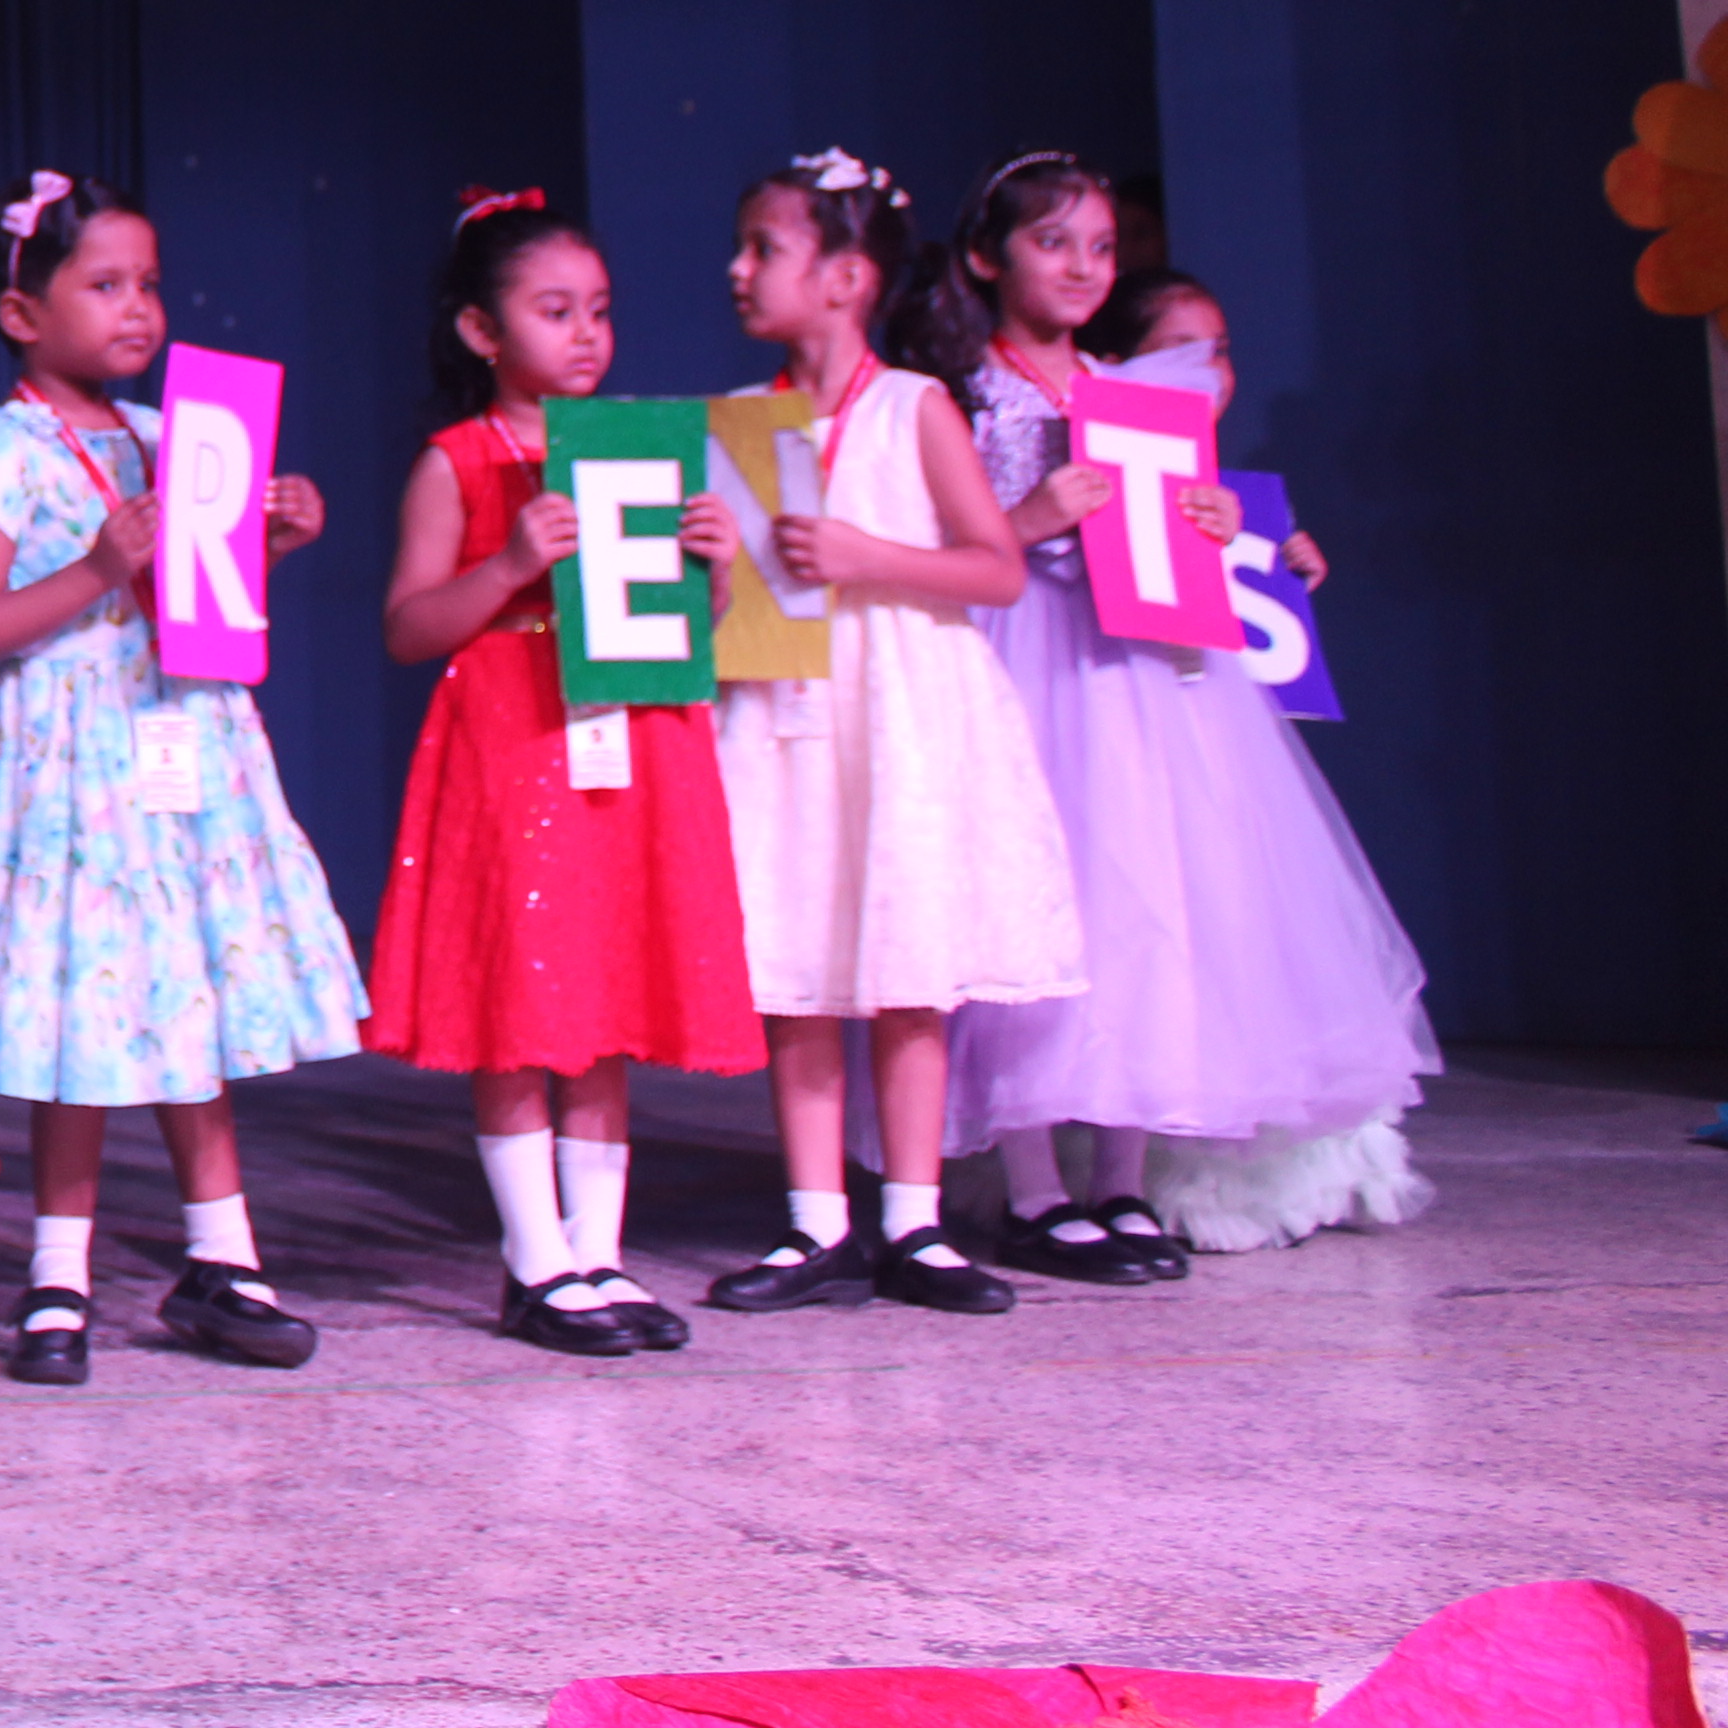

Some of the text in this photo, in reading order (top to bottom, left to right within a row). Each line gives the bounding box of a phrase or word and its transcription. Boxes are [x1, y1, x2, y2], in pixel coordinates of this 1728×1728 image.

[165, 399, 268, 631] R
[572, 459, 691, 662] E
[1084, 419, 1199, 608] T
[1220, 530, 1311, 686] S
